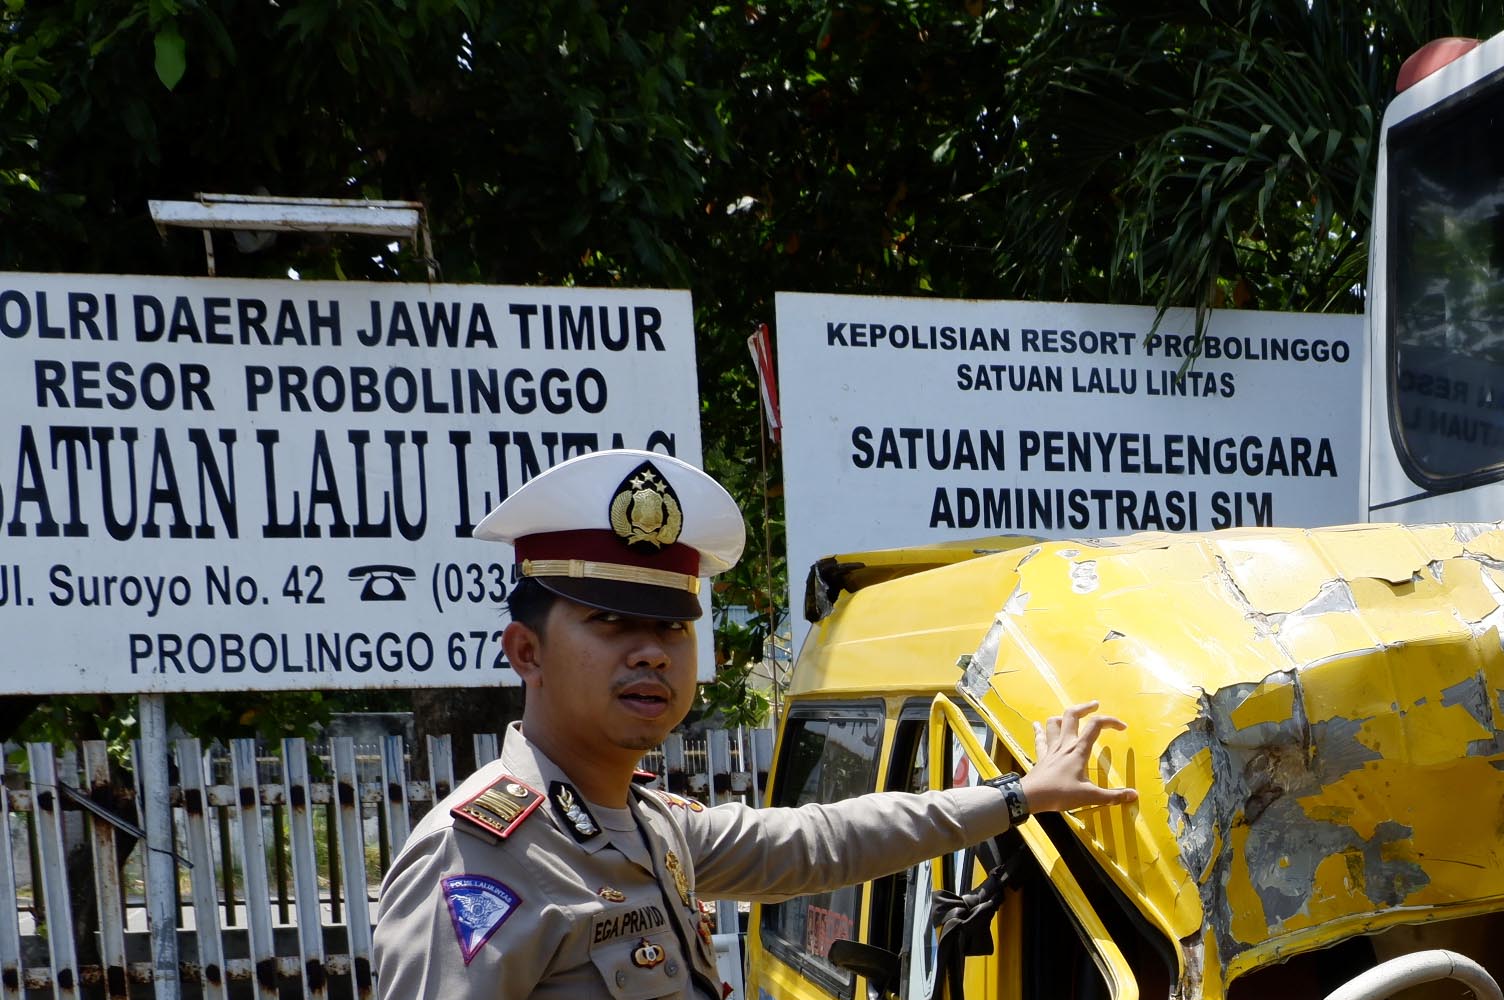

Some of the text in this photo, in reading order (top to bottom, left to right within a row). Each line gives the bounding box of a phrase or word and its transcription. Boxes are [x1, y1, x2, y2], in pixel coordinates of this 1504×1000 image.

[132, 294, 342, 347] DAERAH
[356, 300, 498, 349] JAWA
[508, 303, 667, 352] TIMUR
[826, 322, 1350, 363] KEPOLISIAN RESORT PROBOLINGGO
[34, 359, 608, 415] RESOR PROBOLINGGO
[957, 363, 1235, 398] SATUAN LALU LINTAS
[851, 426, 1338, 478] SATUAN PENYELENGGARA
[0, 424, 239, 541] ATUAN
[255, 429, 429, 541] LALU
[929, 487, 1273, 532] ADMINISTRASI SIM
[49, 564, 191, 618] Suroyo
[205, 565, 269, 606] No.
[282, 564, 325, 604] 42
[432, 562, 516, 614] (033
[129, 631, 434, 674] PROBOLINGGO
[594, 917, 618, 943] EGA
